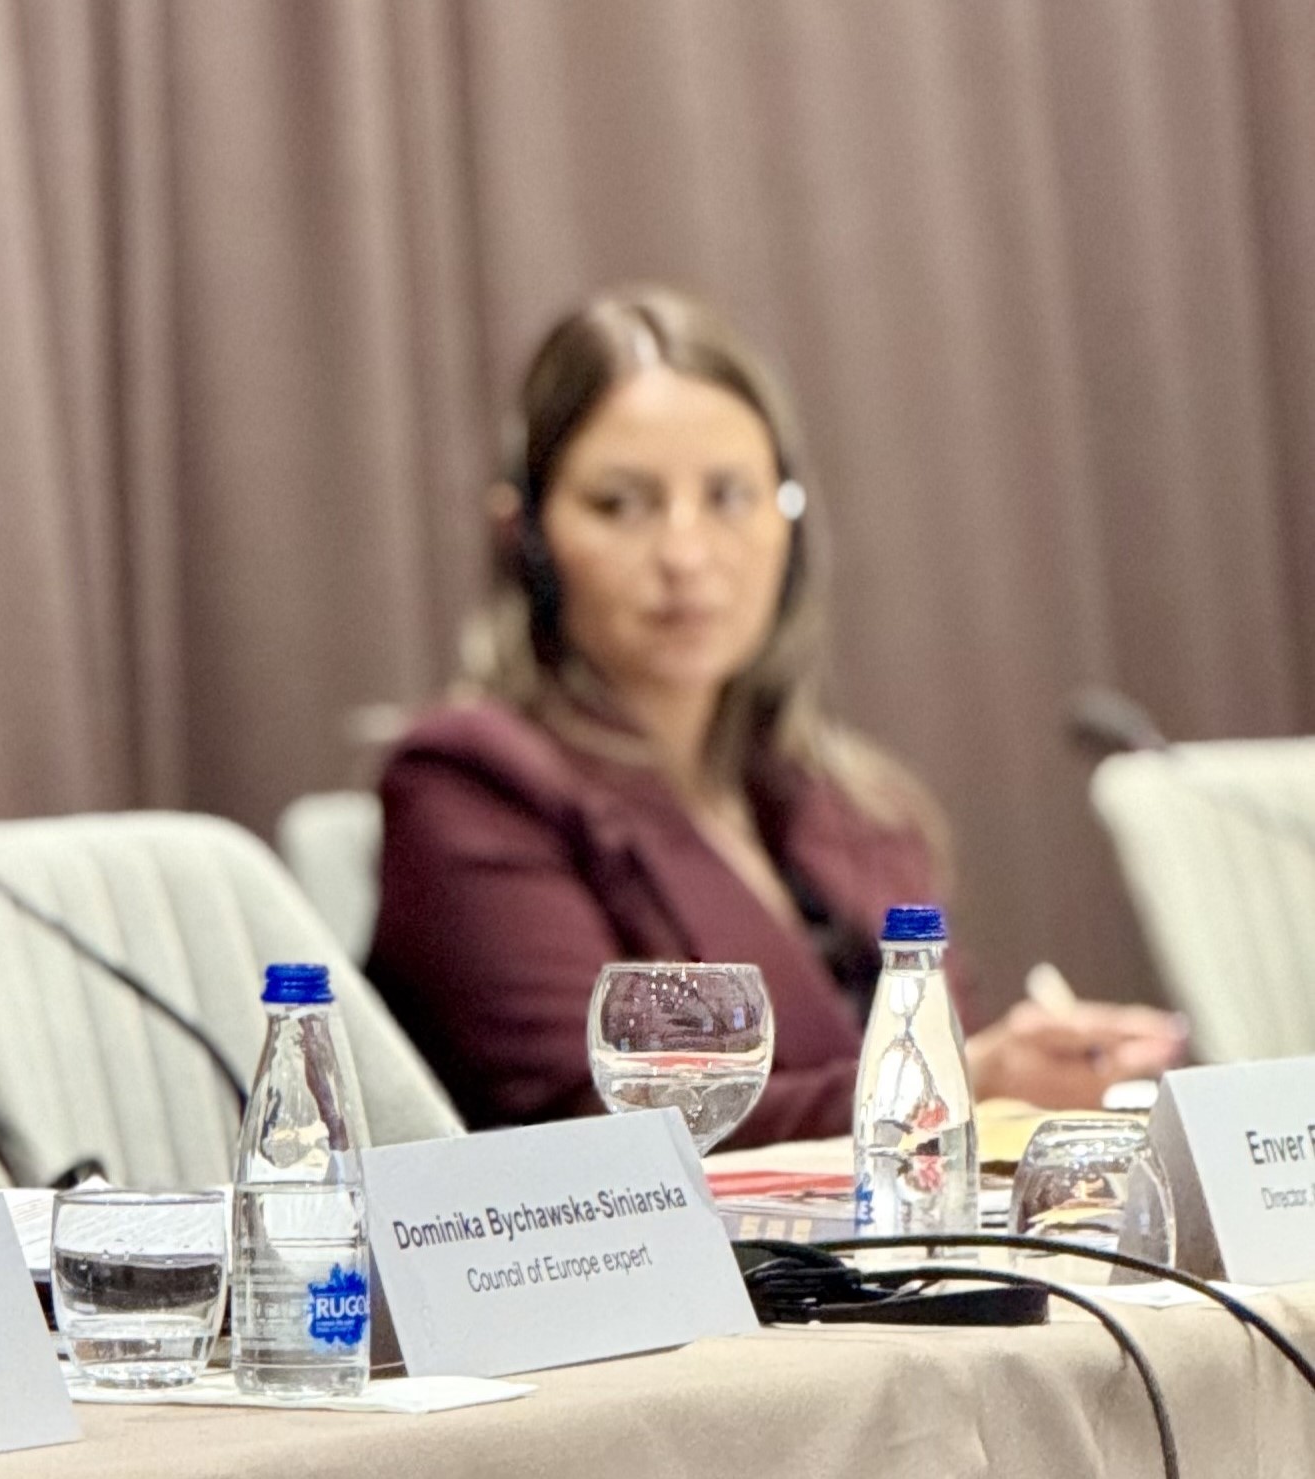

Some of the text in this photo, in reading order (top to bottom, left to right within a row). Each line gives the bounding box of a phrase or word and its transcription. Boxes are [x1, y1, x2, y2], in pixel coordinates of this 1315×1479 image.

[1245, 1130, 1306, 1165] Enver
[393, 1182, 687, 1250] Dominika Bychawska-Siniarska
[467, 1245, 653, 1293] Council of Europe expert
